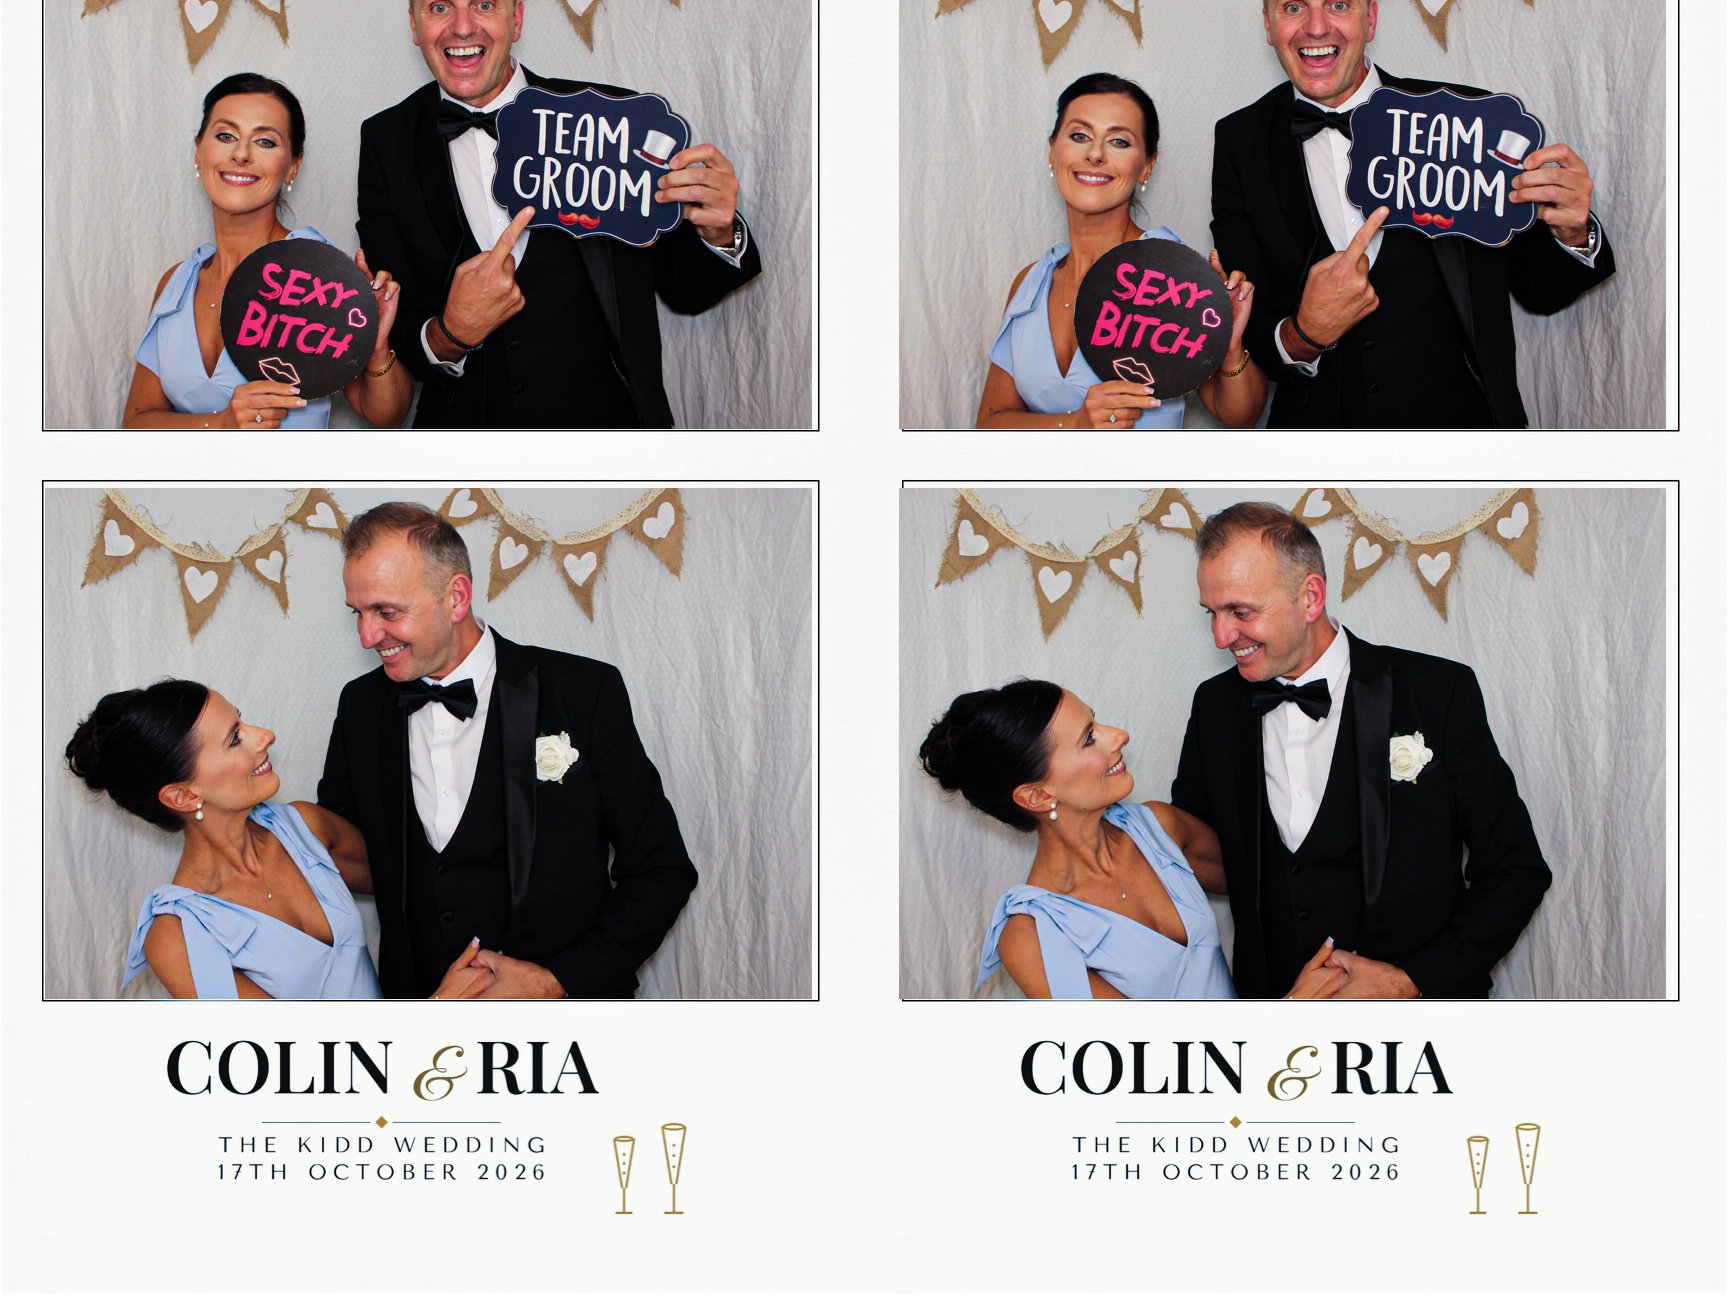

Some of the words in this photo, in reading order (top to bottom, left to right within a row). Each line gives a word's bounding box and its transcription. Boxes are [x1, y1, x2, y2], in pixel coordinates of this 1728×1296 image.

[532, 109, 629, 164] TEAM
[1386, 109, 1483, 164] TEAM
[513, 156, 651, 217] GROOM
[1367, 156, 1505, 217] GROOM
[258, 262, 359, 308] SEXY
[1112, 262, 1213, 308] SEXY
[236, 300, 353, 359] BITCH
[1090, 300, 1207, 359] BITCH
